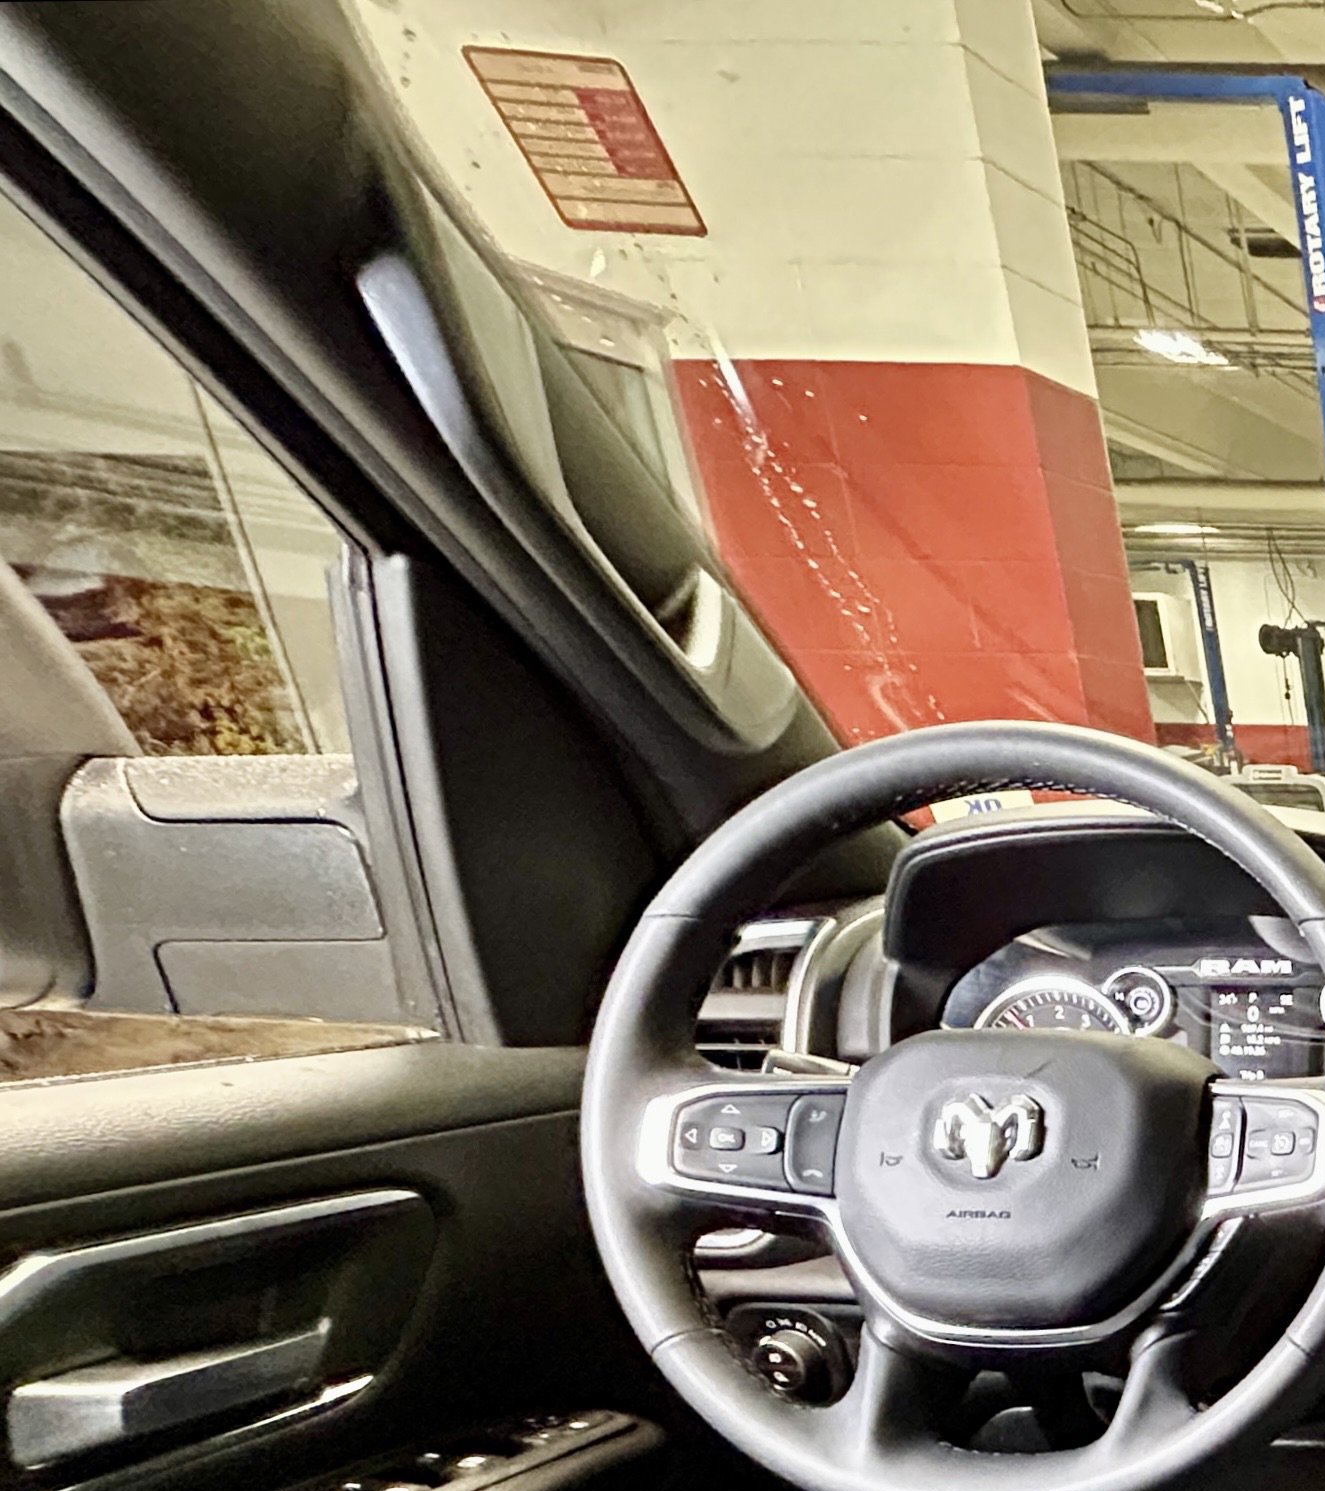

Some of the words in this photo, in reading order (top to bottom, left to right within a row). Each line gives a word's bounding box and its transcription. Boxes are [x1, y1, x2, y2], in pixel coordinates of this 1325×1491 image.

[1289, 96, 1312, 164] LIFT
[1200, 958, 1293, 976] RAM
[1054, 1006, 1065, 1020] 2
[946, 1210, 1011, 1219] AIRBAG
